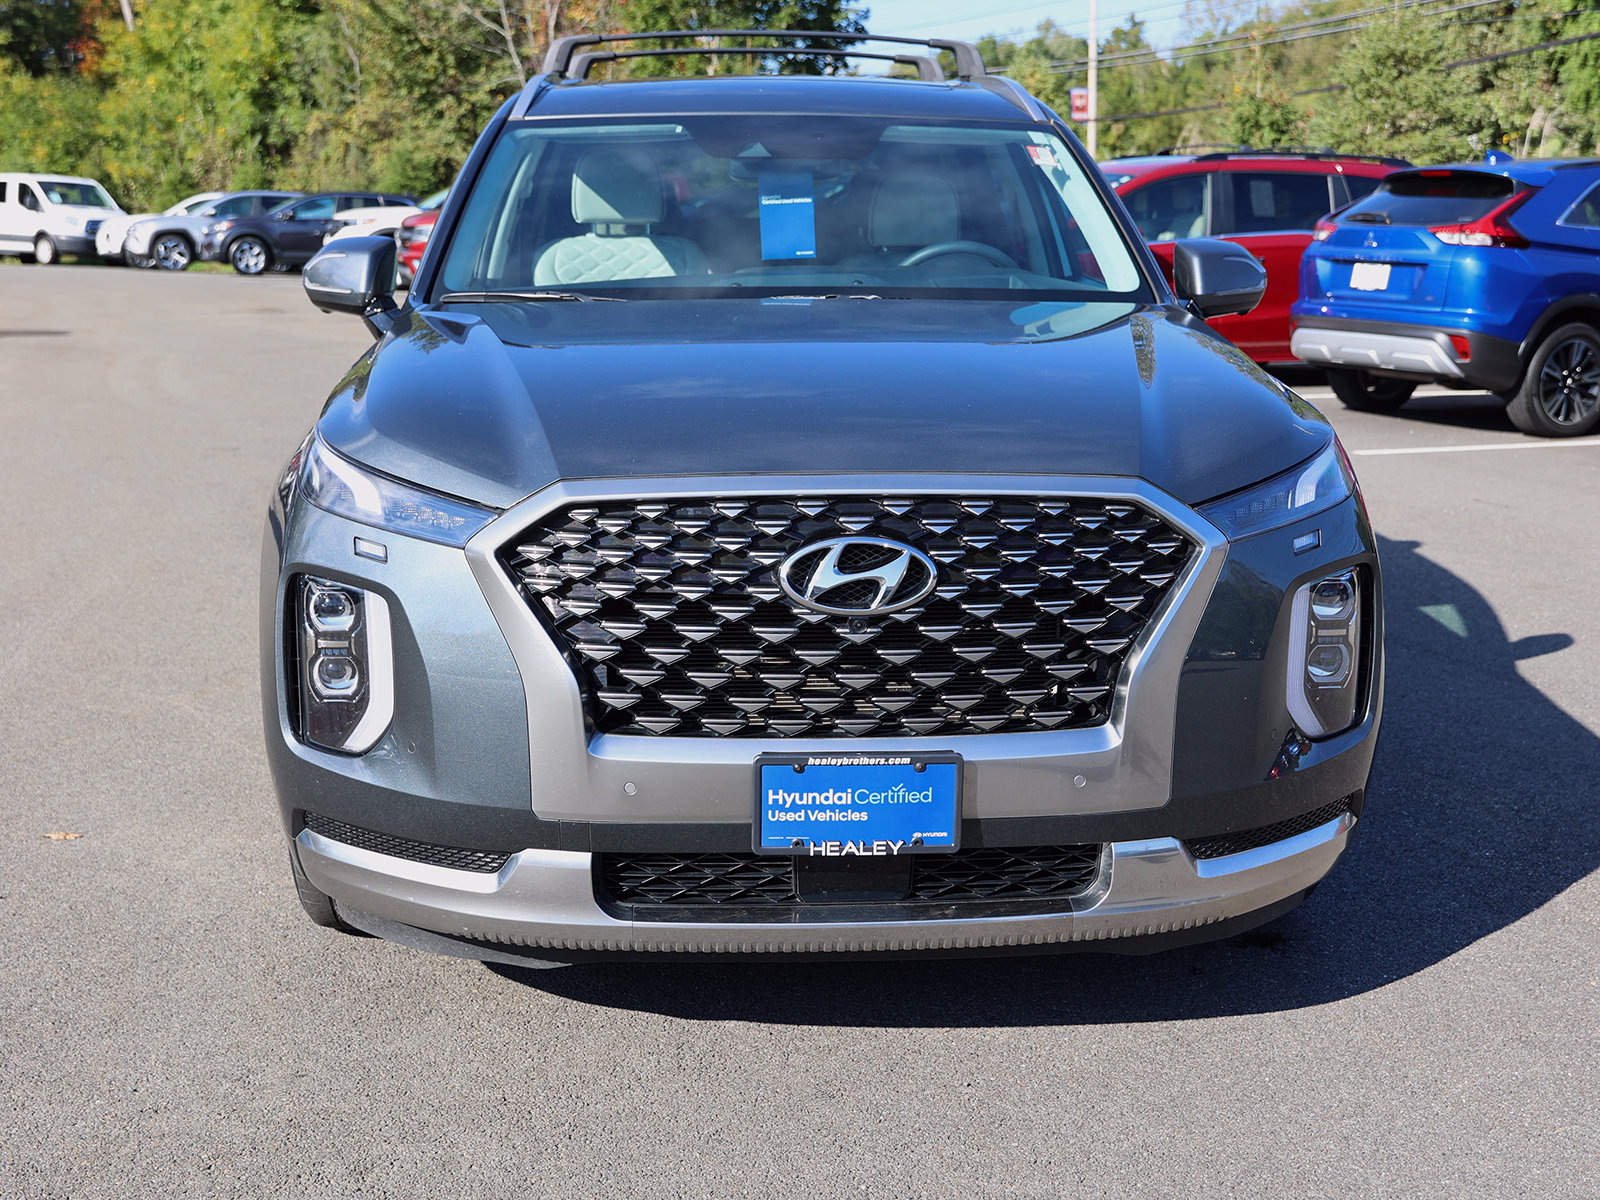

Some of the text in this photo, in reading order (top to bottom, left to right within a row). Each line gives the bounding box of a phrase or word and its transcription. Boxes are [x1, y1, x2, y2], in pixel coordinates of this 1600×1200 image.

[807, 757, 911, 766] healeybrothers.com
[768, 783, 932, 808] Hyundai Certified
[768, 809, 868, 821] Used Vehicles
[809, 840, 904, 856] HEALEY
